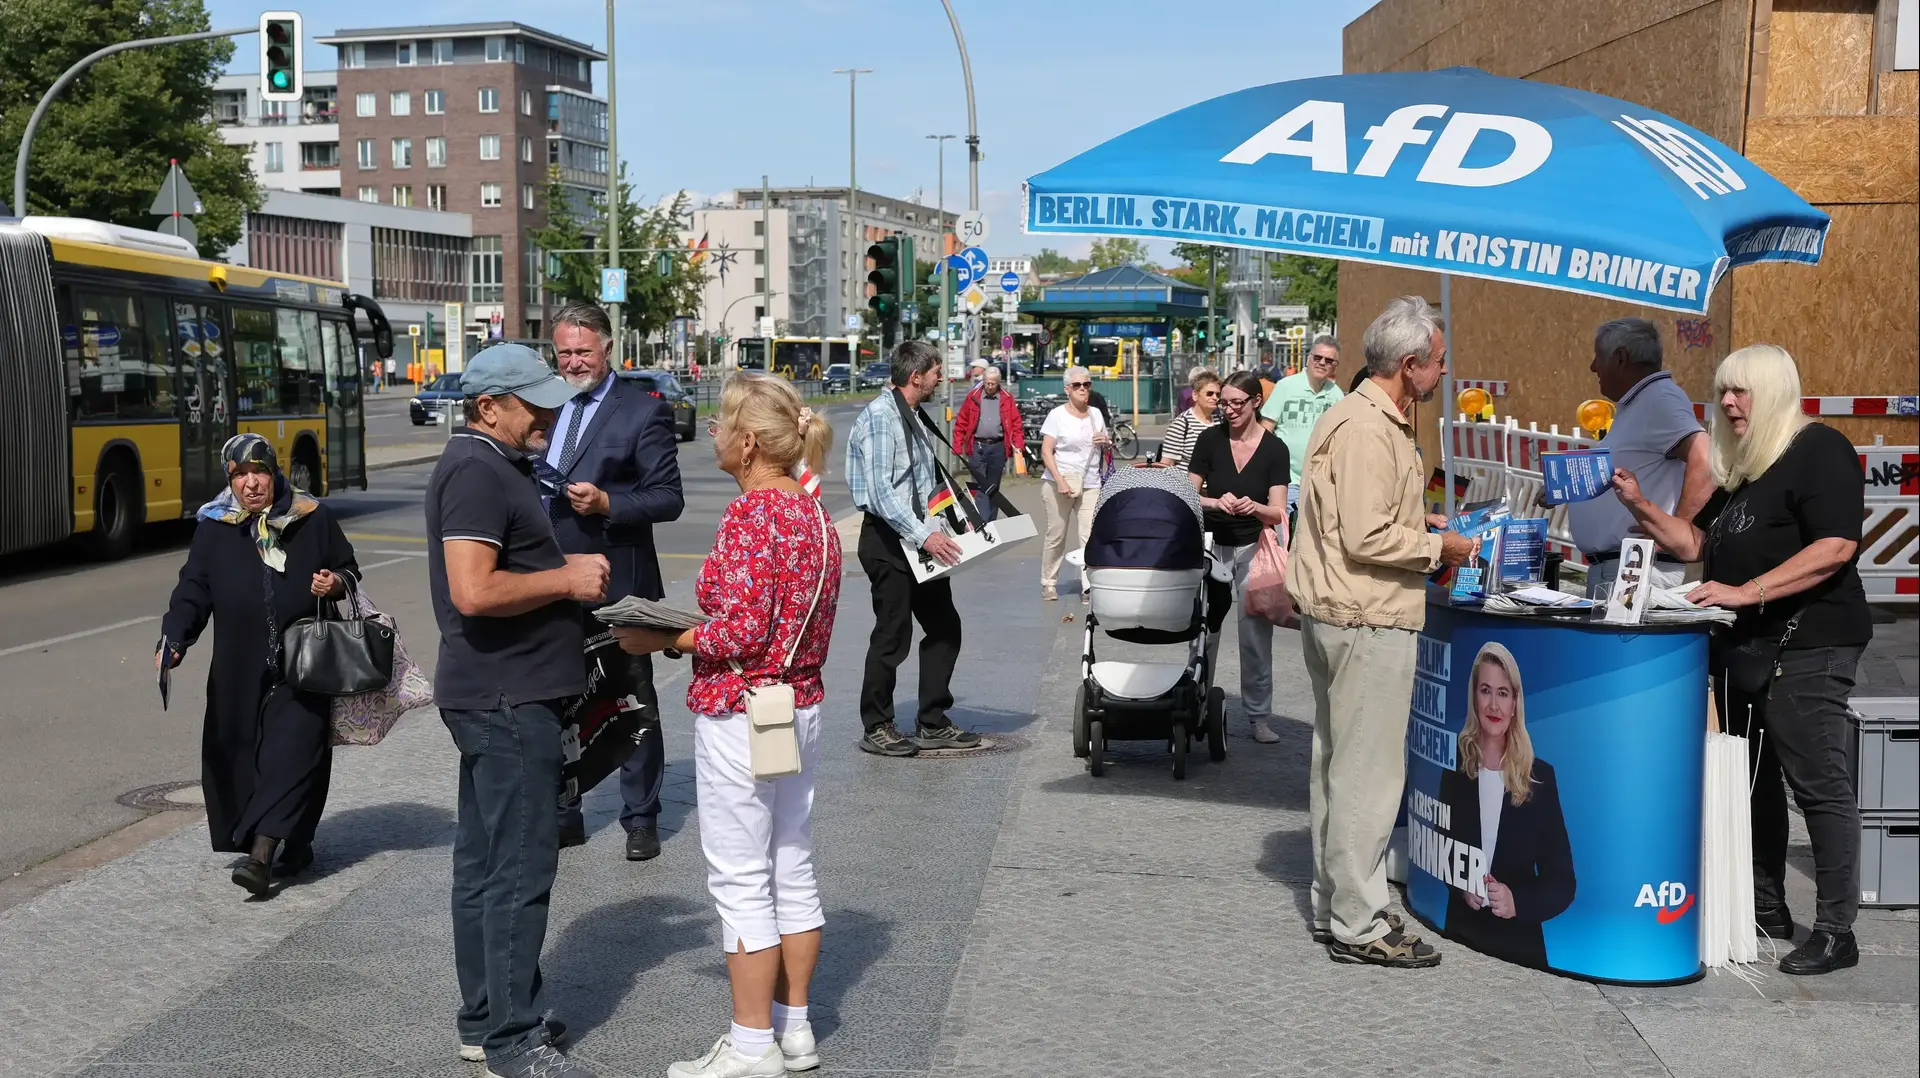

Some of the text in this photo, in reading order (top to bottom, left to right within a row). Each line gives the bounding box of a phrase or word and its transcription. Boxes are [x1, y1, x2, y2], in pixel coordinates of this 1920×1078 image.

[1219, 99, 1553, 187] AfD
[1611, 114, 1747, 200] AfD
[964, 220, 983, 236] 50
[1039, 195, 1701, 301] BERLIN. STARK. MACHEN. mit KRISTIN BRINKER
[1088, 324, 1096, 336] U
[1412, 681, 1444, 720] TARK.
[1414, 788, 1451, 831] KRISTIN
[1634, 880, 1687, 908] AfD
